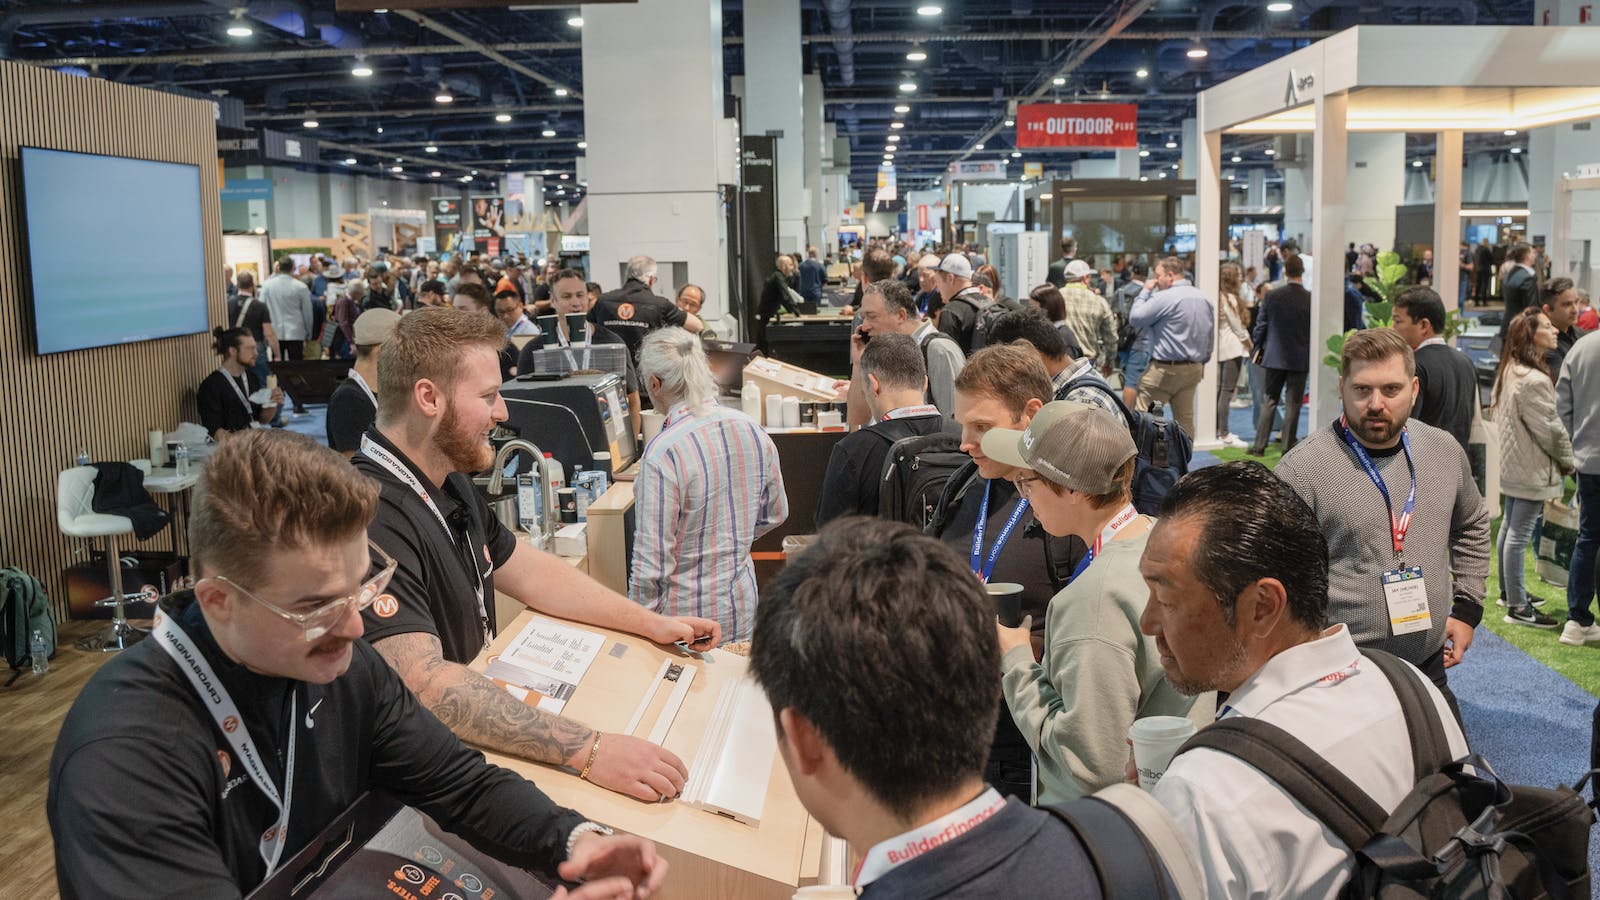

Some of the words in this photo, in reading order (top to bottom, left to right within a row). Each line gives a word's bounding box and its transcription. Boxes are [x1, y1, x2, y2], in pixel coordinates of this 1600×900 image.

[1027, 121, 1045, 131] THE
[1046, 117, 1114, 135] OUTDOOR
[1114, 121, 1135, 131] PLUS
[988, 498, 1027, 562] uilderFinance.com
[164, 630, 222, 704] MAGNABOARD
